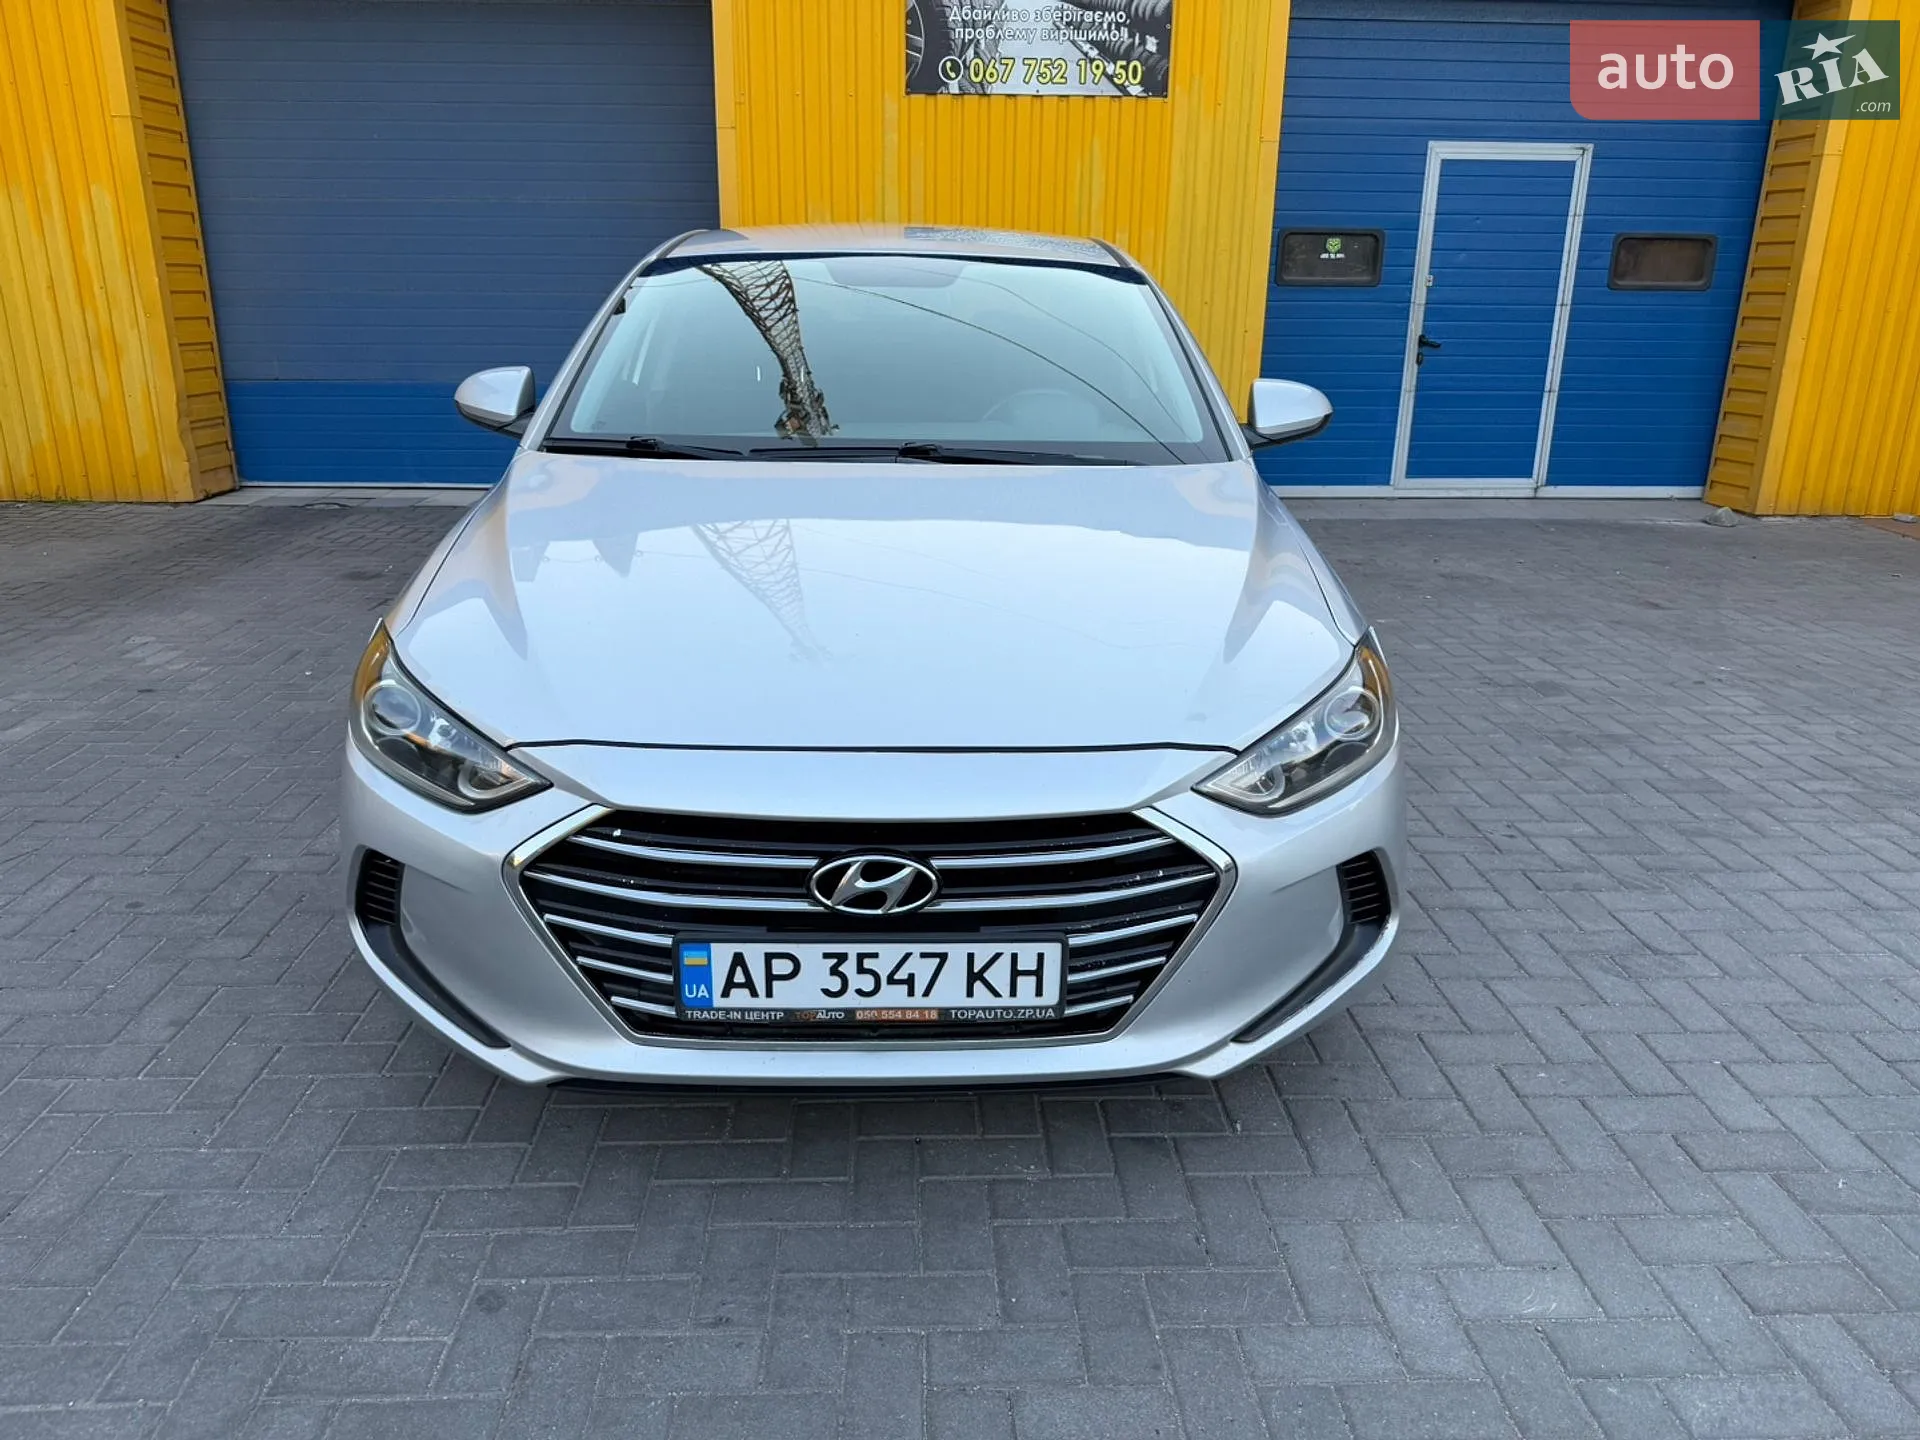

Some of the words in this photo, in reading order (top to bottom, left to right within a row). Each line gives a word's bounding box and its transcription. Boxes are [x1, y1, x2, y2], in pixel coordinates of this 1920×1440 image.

[949, 5, 1030, 22] Дбайливо
[954, 25, 1037, 44] проблему
[969, 58, 1016, 84] 067
[1023, 58, 1067, 84] 752
[1077, 59, 1105, 84] 19
[1113, 59, 1143, 85] 50
[720, 951, 802, 998] AP
[820, 951, 948, 998] 3547
[965, 951, 1045, 998] KH
[685, 983, 709, 998] UA
[686, 1010, 742, 1020] TRADE-IN
[744, 1011, 784, 1021] ЦЕНТР
[904, 1009, 920, 1019] 84
[923, 1009, 938, 1019] 18
[950, 1008, 1055, 1019] TOPAUTO.ZP.UA
